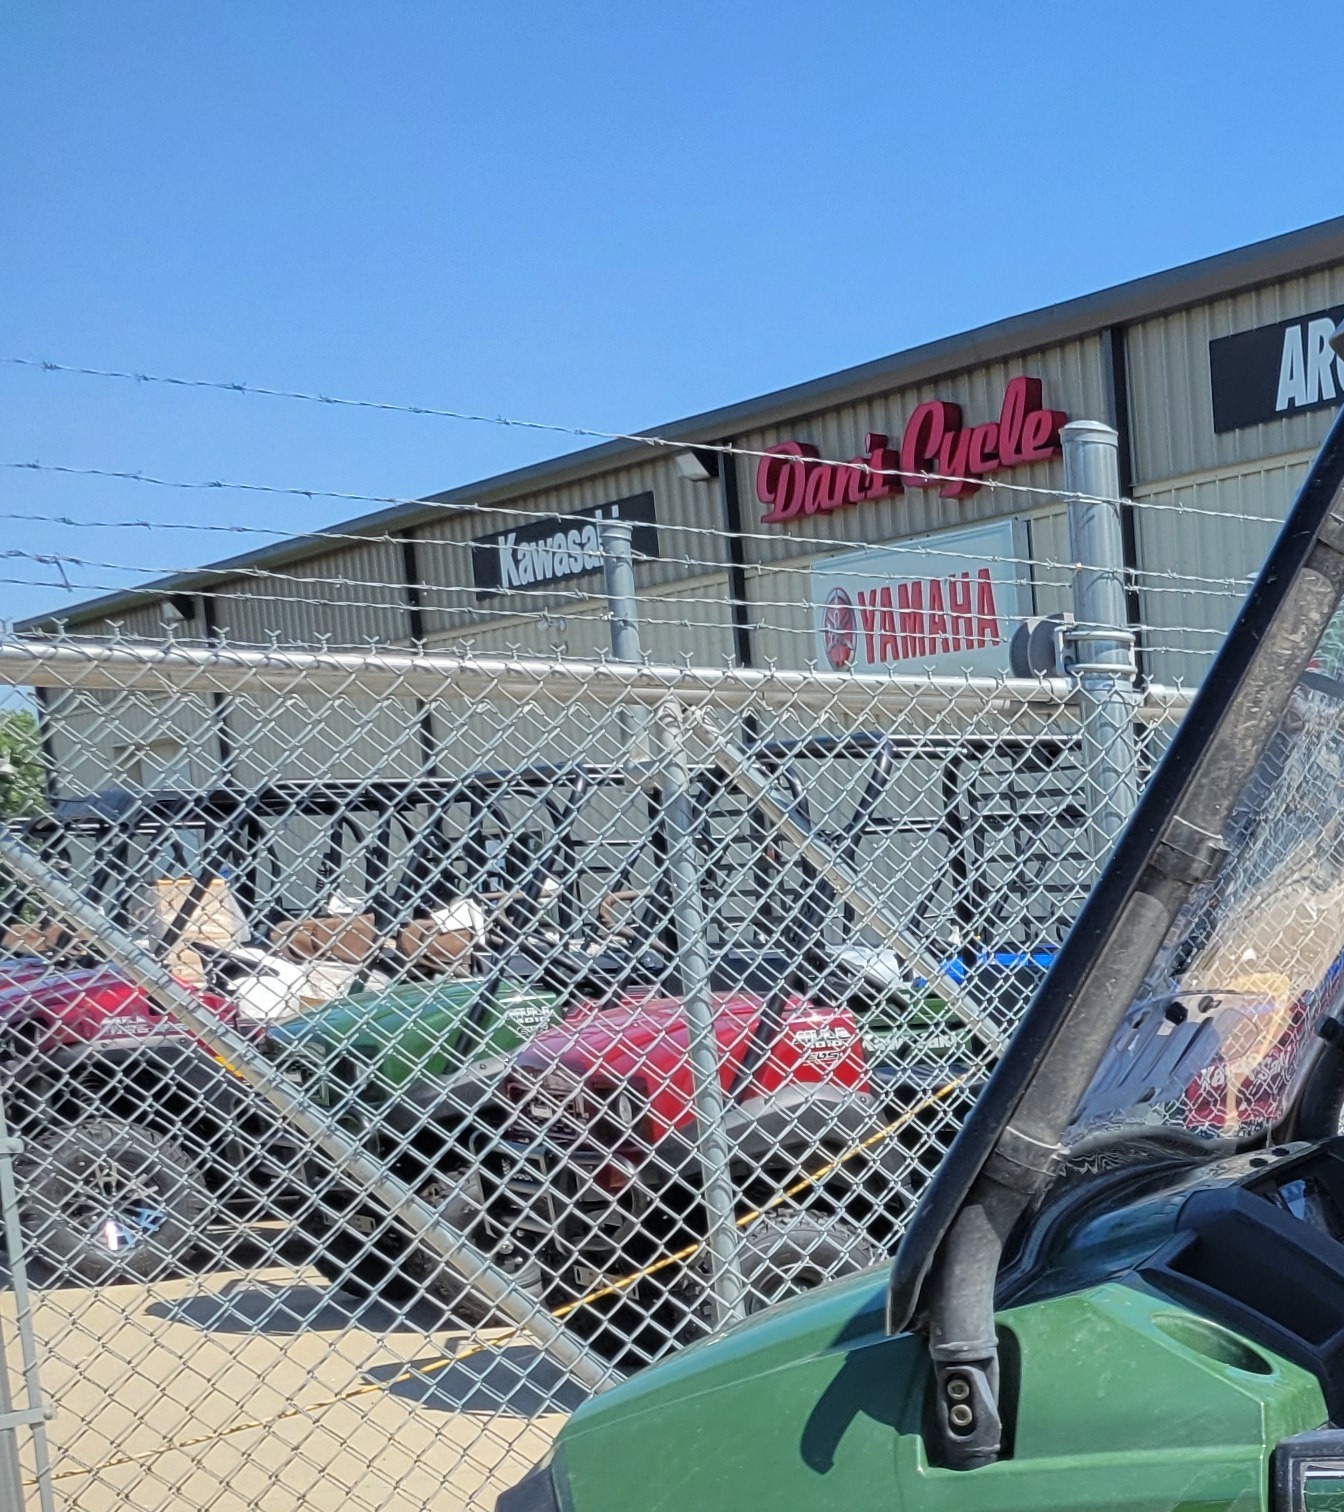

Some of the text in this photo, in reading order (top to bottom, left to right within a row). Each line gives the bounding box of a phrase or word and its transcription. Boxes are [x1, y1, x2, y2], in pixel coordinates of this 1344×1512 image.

[757, 376, 1069, 524] Dan's Cycle
[857, 568, 1000, 665] YAMAHA
